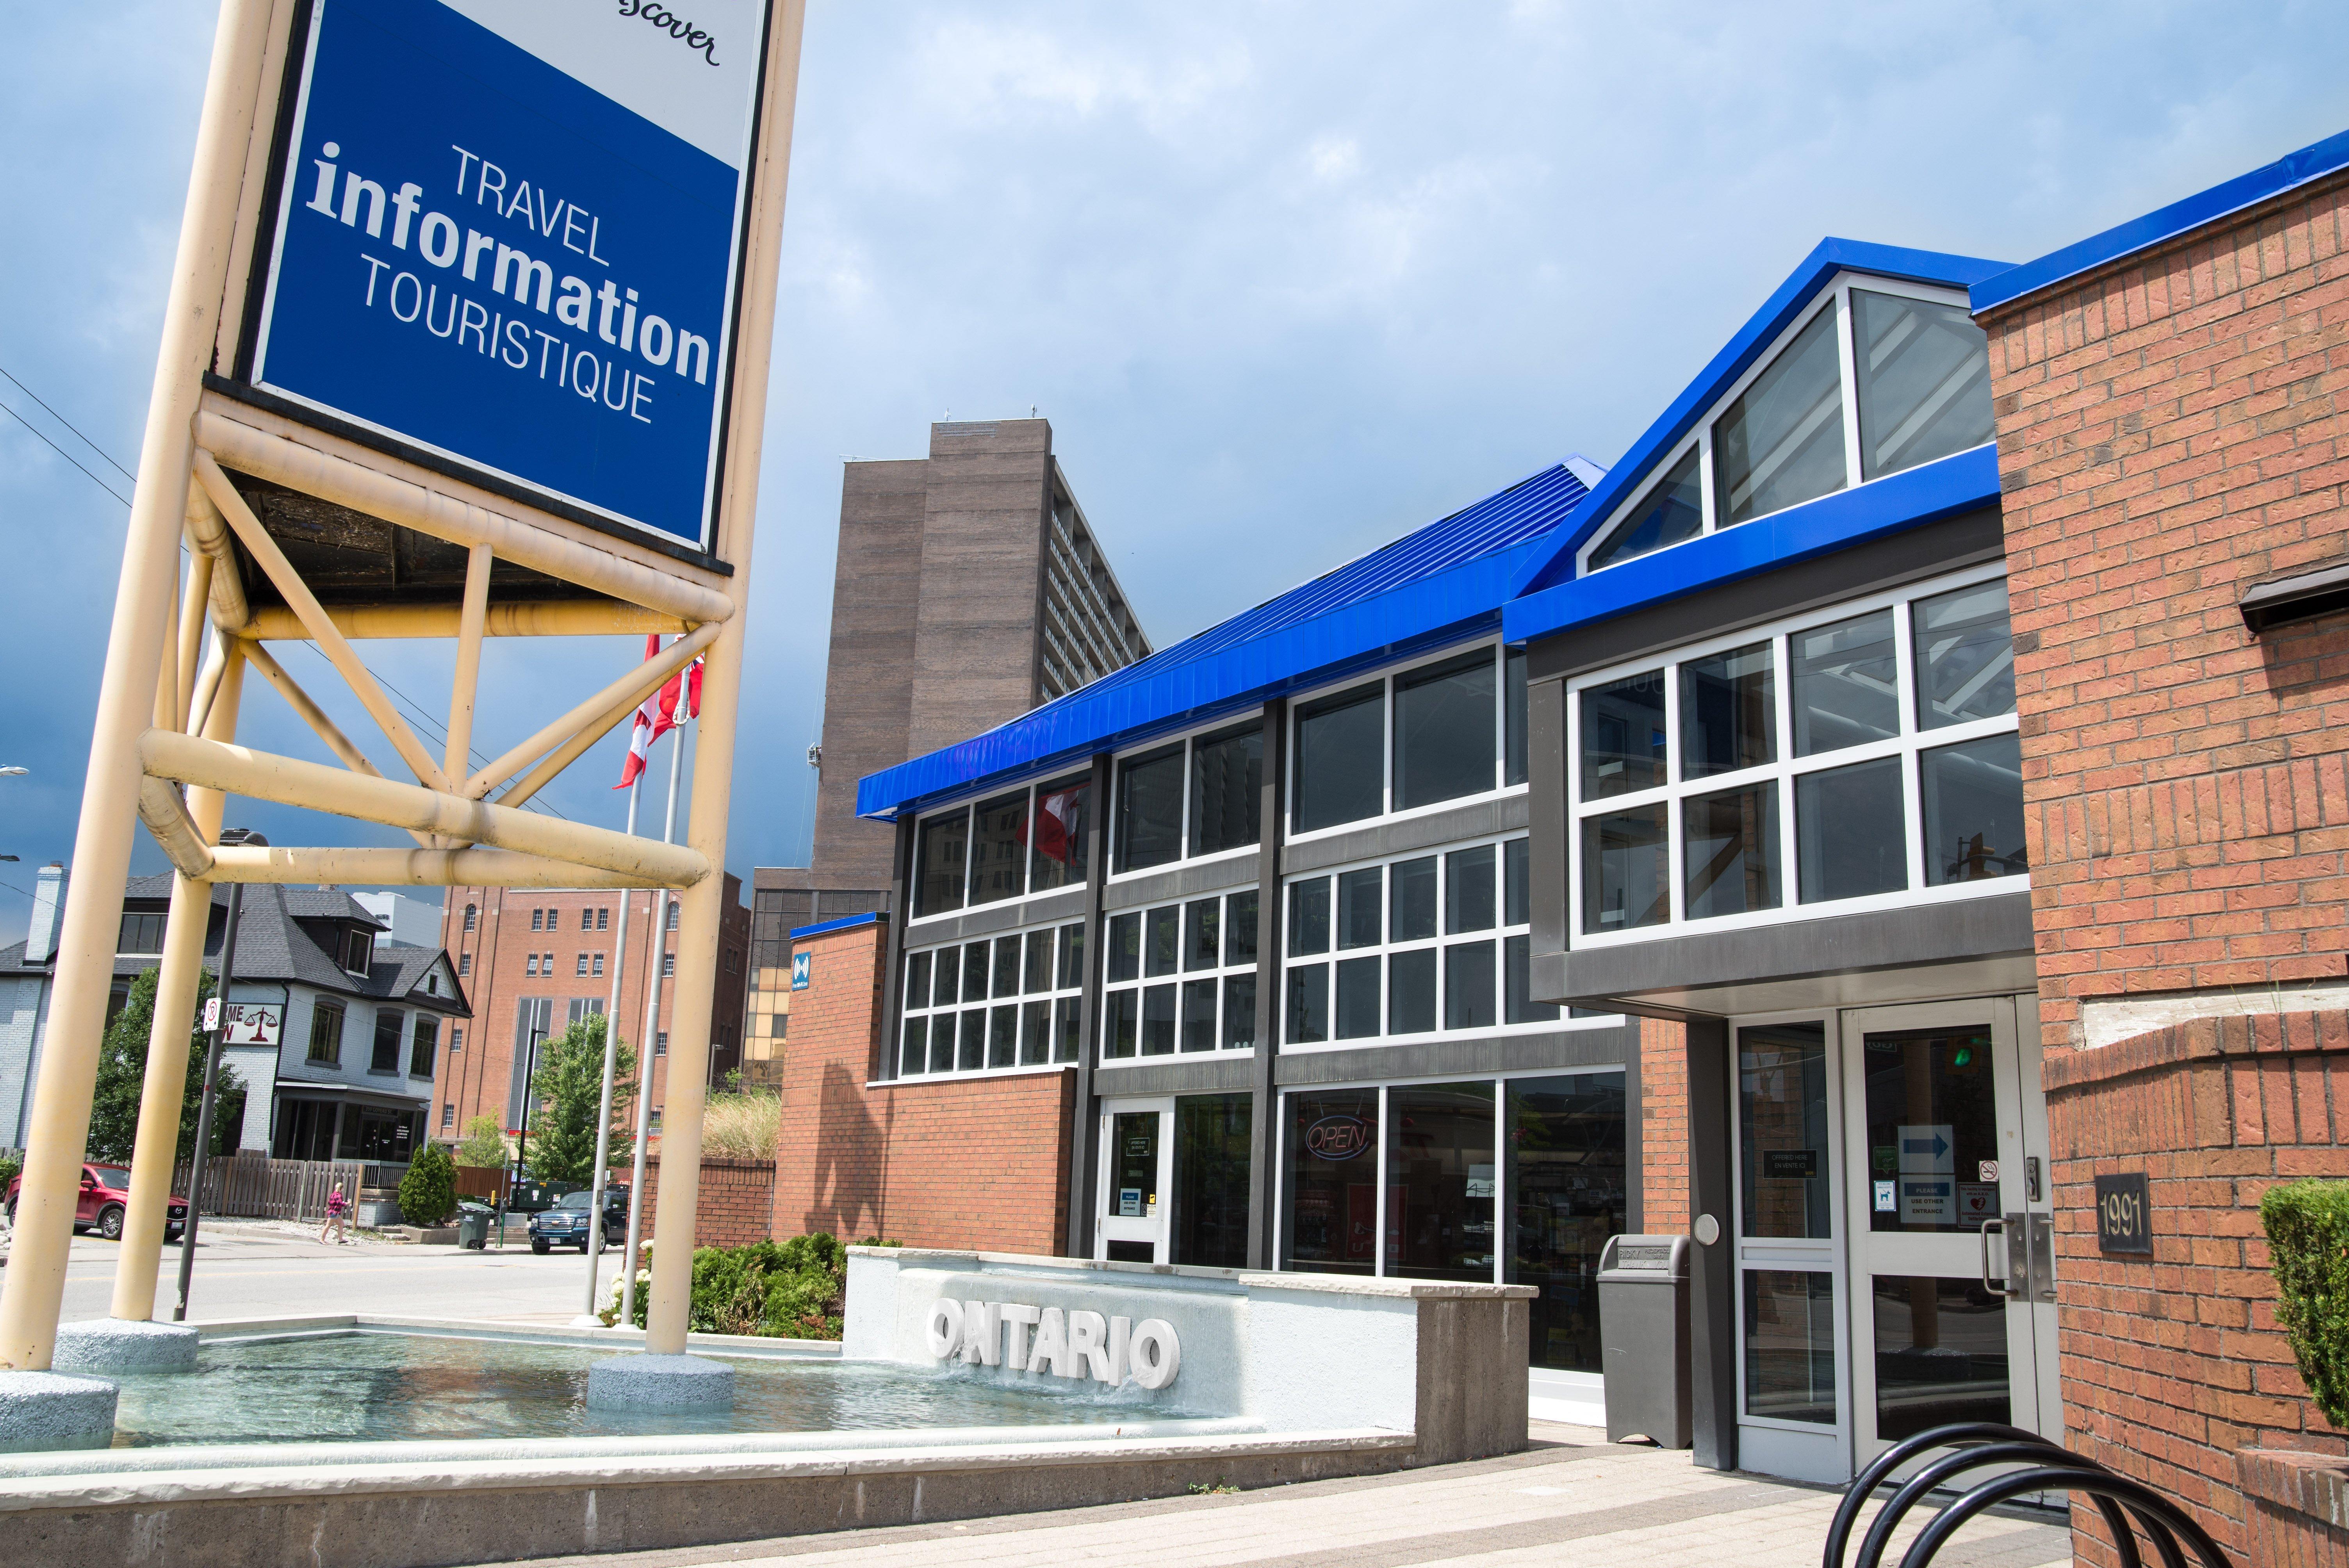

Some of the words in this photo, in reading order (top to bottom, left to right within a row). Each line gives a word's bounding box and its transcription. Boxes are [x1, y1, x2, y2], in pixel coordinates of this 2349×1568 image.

[452, 144, 610, 267] TRAVEL
[306, 141, 709, 385] information
[361, 253, 655, 424] TOURISTIQUE
[226, 1006, 244, 1021] ME
[1309, 1125, 1366, 1148] OPEN
[2099, 1190, 2142, 1236] 1991
[1619, 1249, 1640, 1259] RICKY
[1622, 1260, 1647, 1269] THANK
[1655, 1260, 1669, 1269] YOU
[926, 1297, 1181, 1389] ONTARIO
